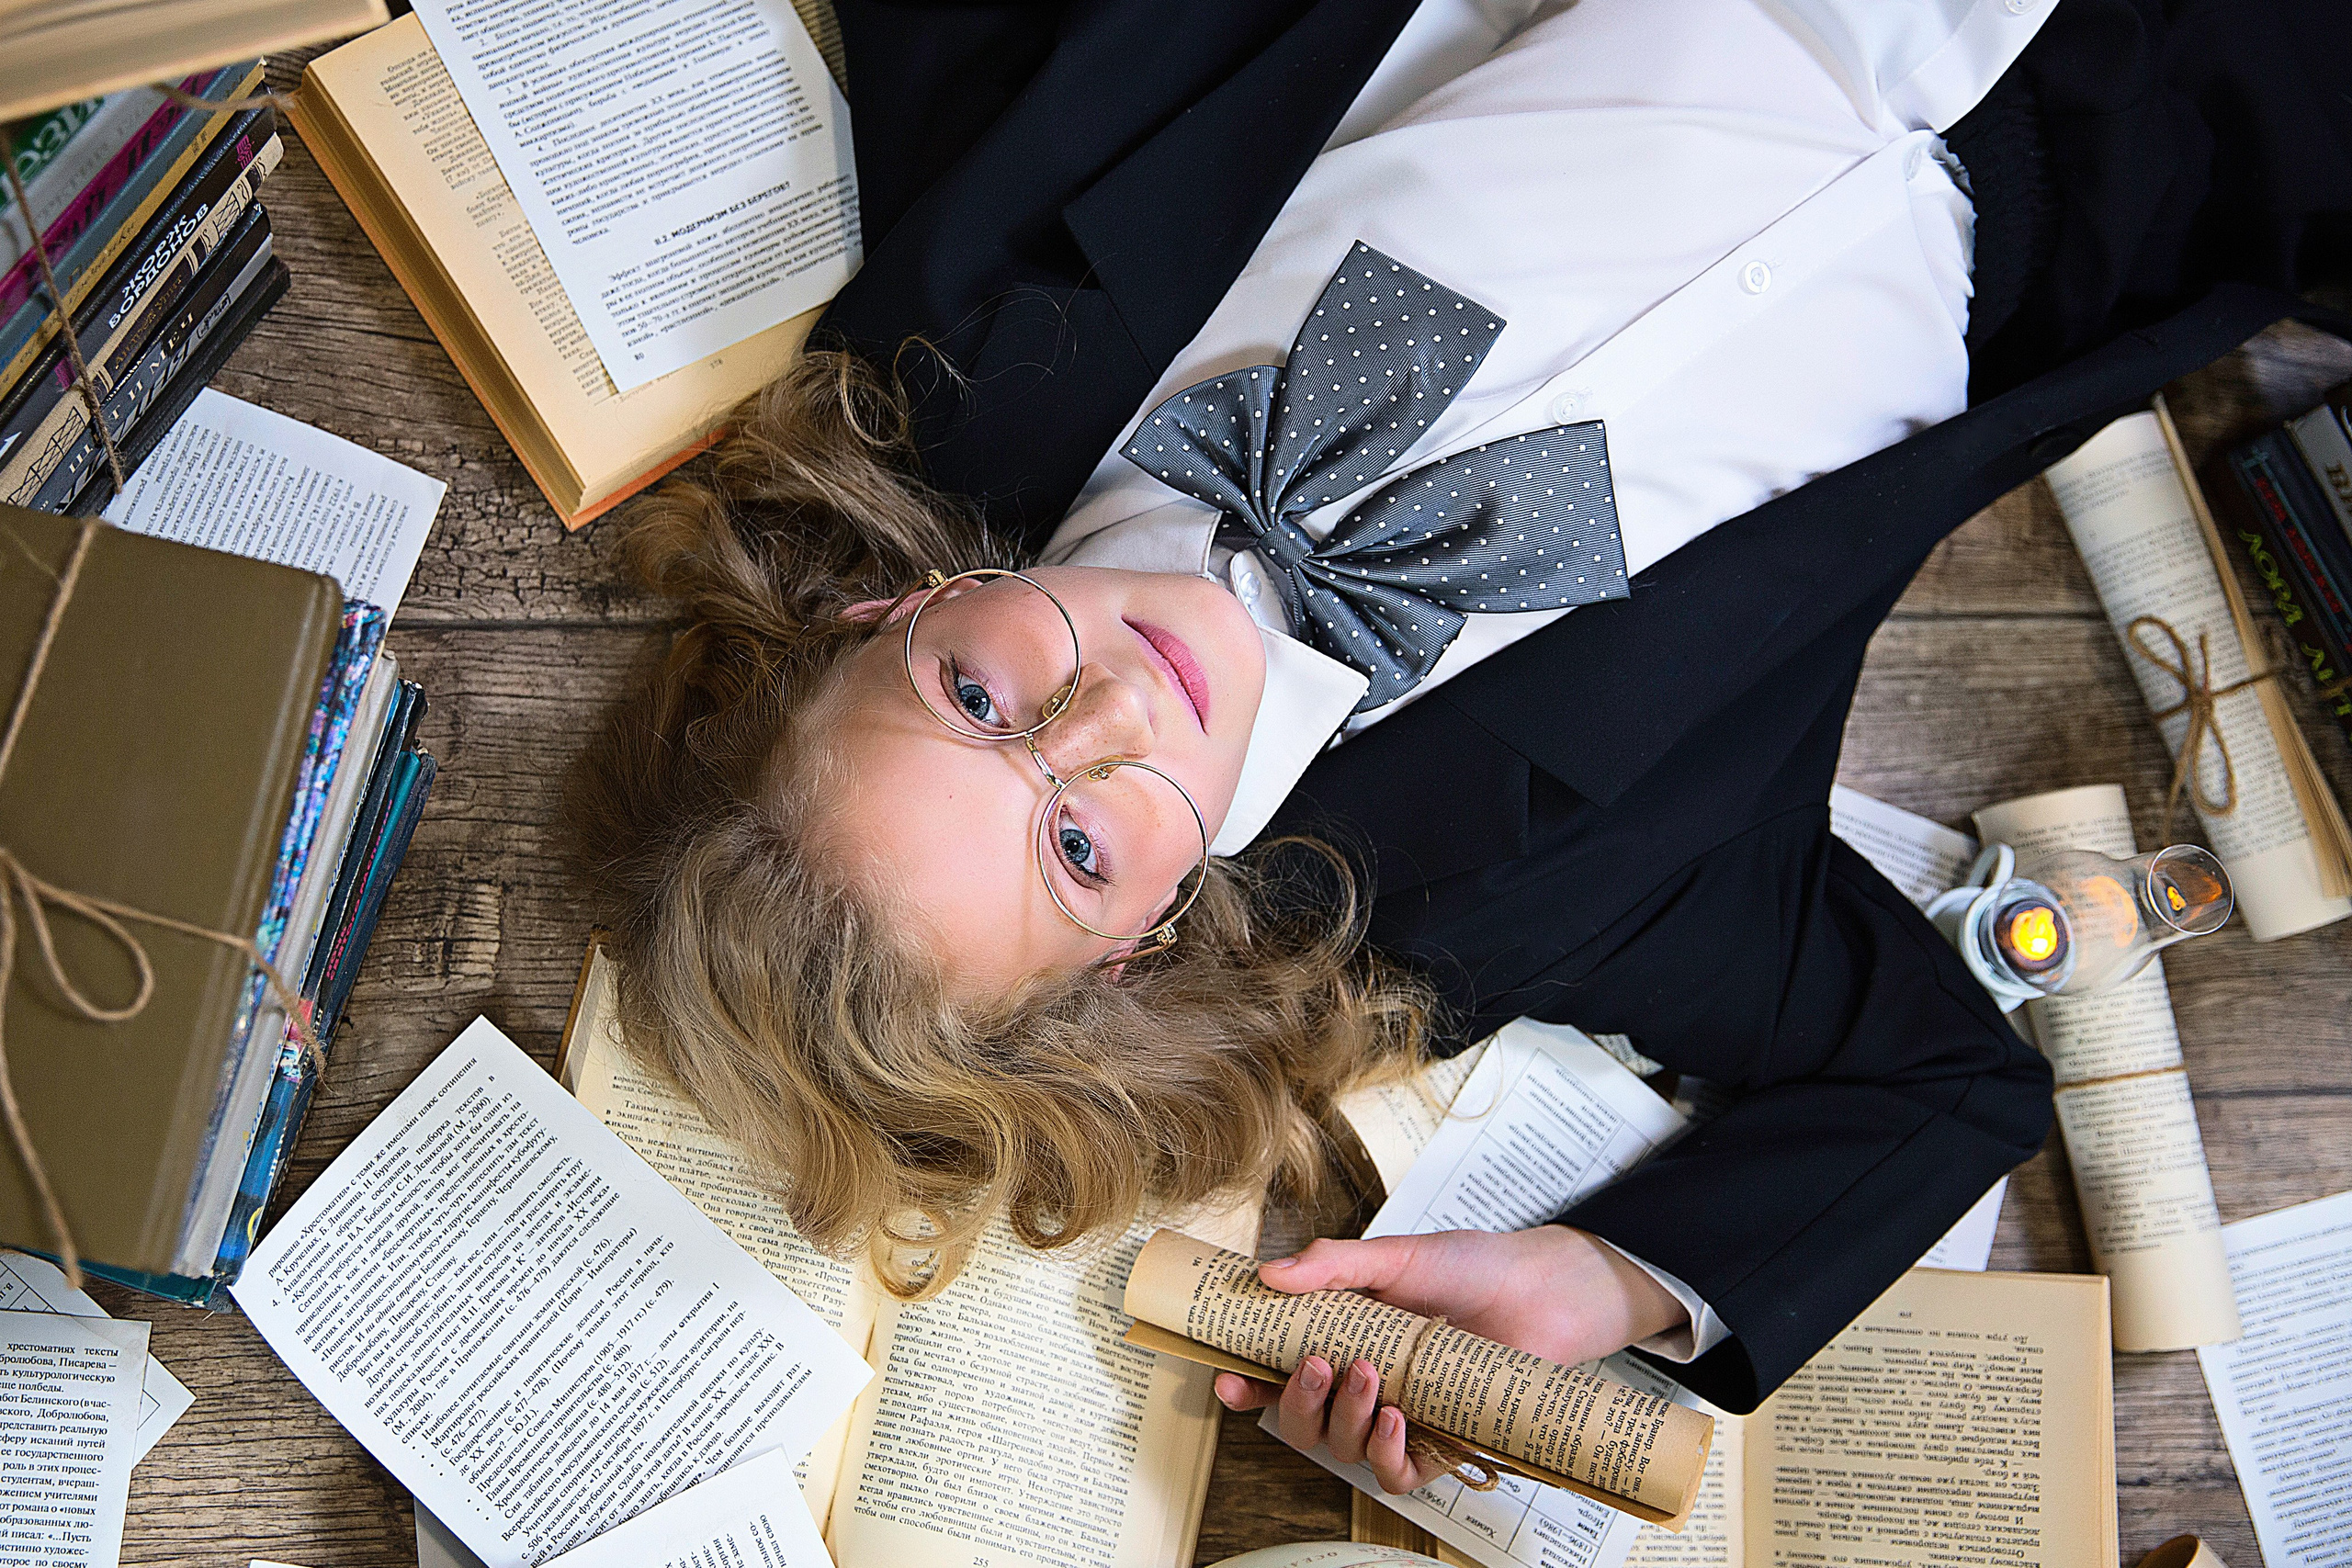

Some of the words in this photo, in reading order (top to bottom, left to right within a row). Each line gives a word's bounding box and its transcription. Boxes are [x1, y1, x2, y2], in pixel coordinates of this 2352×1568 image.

[122, 215, 187, 298] ЖОРЖ
[108, 203, 208, 328] БОРДОНОВ
[68, 404, 120, 473] ЩТ
[300, 1186, 349, 1239] «Хрестоматия»
[356, 1160, 375, 1179] теми
[374, 1149, 386, 1161] же
[385, 1116, 418, 1150] именами
[418, 1096, 438, 1117] плюс
[437, 1057, 477, 1097] сочинения
[283, 1242, 331, 1295] Аналогичным
[336, 1205, 366, 1236] образом
[371, 1159, 411, 1200] составлена
[415, 1120, 450, 1155] подборка
[455, 1087, 483, 1114] текстов
[292, 1242, 347, 1303] «Культурологии»
[347, 1226, 365, 1241] В.А.
[364, 1197, 390, 1224] Бобахо
[396, 1174, 415, 1190] С.И.
[413, 1133, 454, 1174] Левиковой
[453, 1120, 471, 1134] (М.,
[469, 1097, 492, 1118] 2000).
[336, 1327, 390, 1382] Добролюбову,
[389, 1288, 427, 1325] Писареву,
[425, 1256, 458, 1287] Стасову.
[421, 1401, 459, 1439] Наиболее
[458, 1354, 503, 1402] почитаемые
[502, 1321, 533, 1354] святыни
[533, 1297, 555, 1320] земли
[555, 1266, 584, 1299] русской
[582, 1258, 594, 1267] (с.
[594, 1238, 612, 1256] 476).
[430, 1400, 476, 1449] Мартиролог
[476, 1355, 519, 1402] российских
[518, 1311, 560, 1355] правителей
[559, 1287, 582, 1312] (Цари
[587, 1227, 637, 1279] Императоры)
[6, 1343, 75, 1354] хрестоматиях
[85, 1348, 119, 1357] тексты
[59, 1357, 107, 1370] Писарева
[12, 1370, 115, 1383] культурологическую
[18, 1382, 64, 1393] полбеды.
[20, 1394, 79, 1407] Белинского
[37, 1408, 108, 1423] Добролюбова,
[59, 1426, 107, 1437] реальную
[30, 1437, 74, 1446] исканий
[77, 1439, 106, 1449] путей
[501, 1477, 560, 1541] Всероссийского
[560, 1414, 617, 1477] мусульманского
[617, 1388, 641, 1414] съезда
[639, 1380, 651, 1389] (с.
[650, 1359, 669, 1378] 512).
[15, 1450, 104, 1461] государственного
[3, 1462, 27, 1471] роль
[62, 1466, 101, 1474] процес-
[1, 1475, 55, 1486] студентам,
[58, 1479, 99, 1488] вчераш-
[44, 1492, 97, 1501] учителями
[1426, 1491, 1446, 1508] 1956
[11, 1504, 49, 1512] романа
[60, 1506, 96, 1516] «новых
[760, 1515, 774, 1539] свою
[11, 1531, 44, 1540] писал:
[48, 1531, 92, 1543] «...Пусть
[43, 1547, 89, 1555] художес-
[771, 1540, 786, 1567] начал
[973, 1556, 989, 1567] 255
